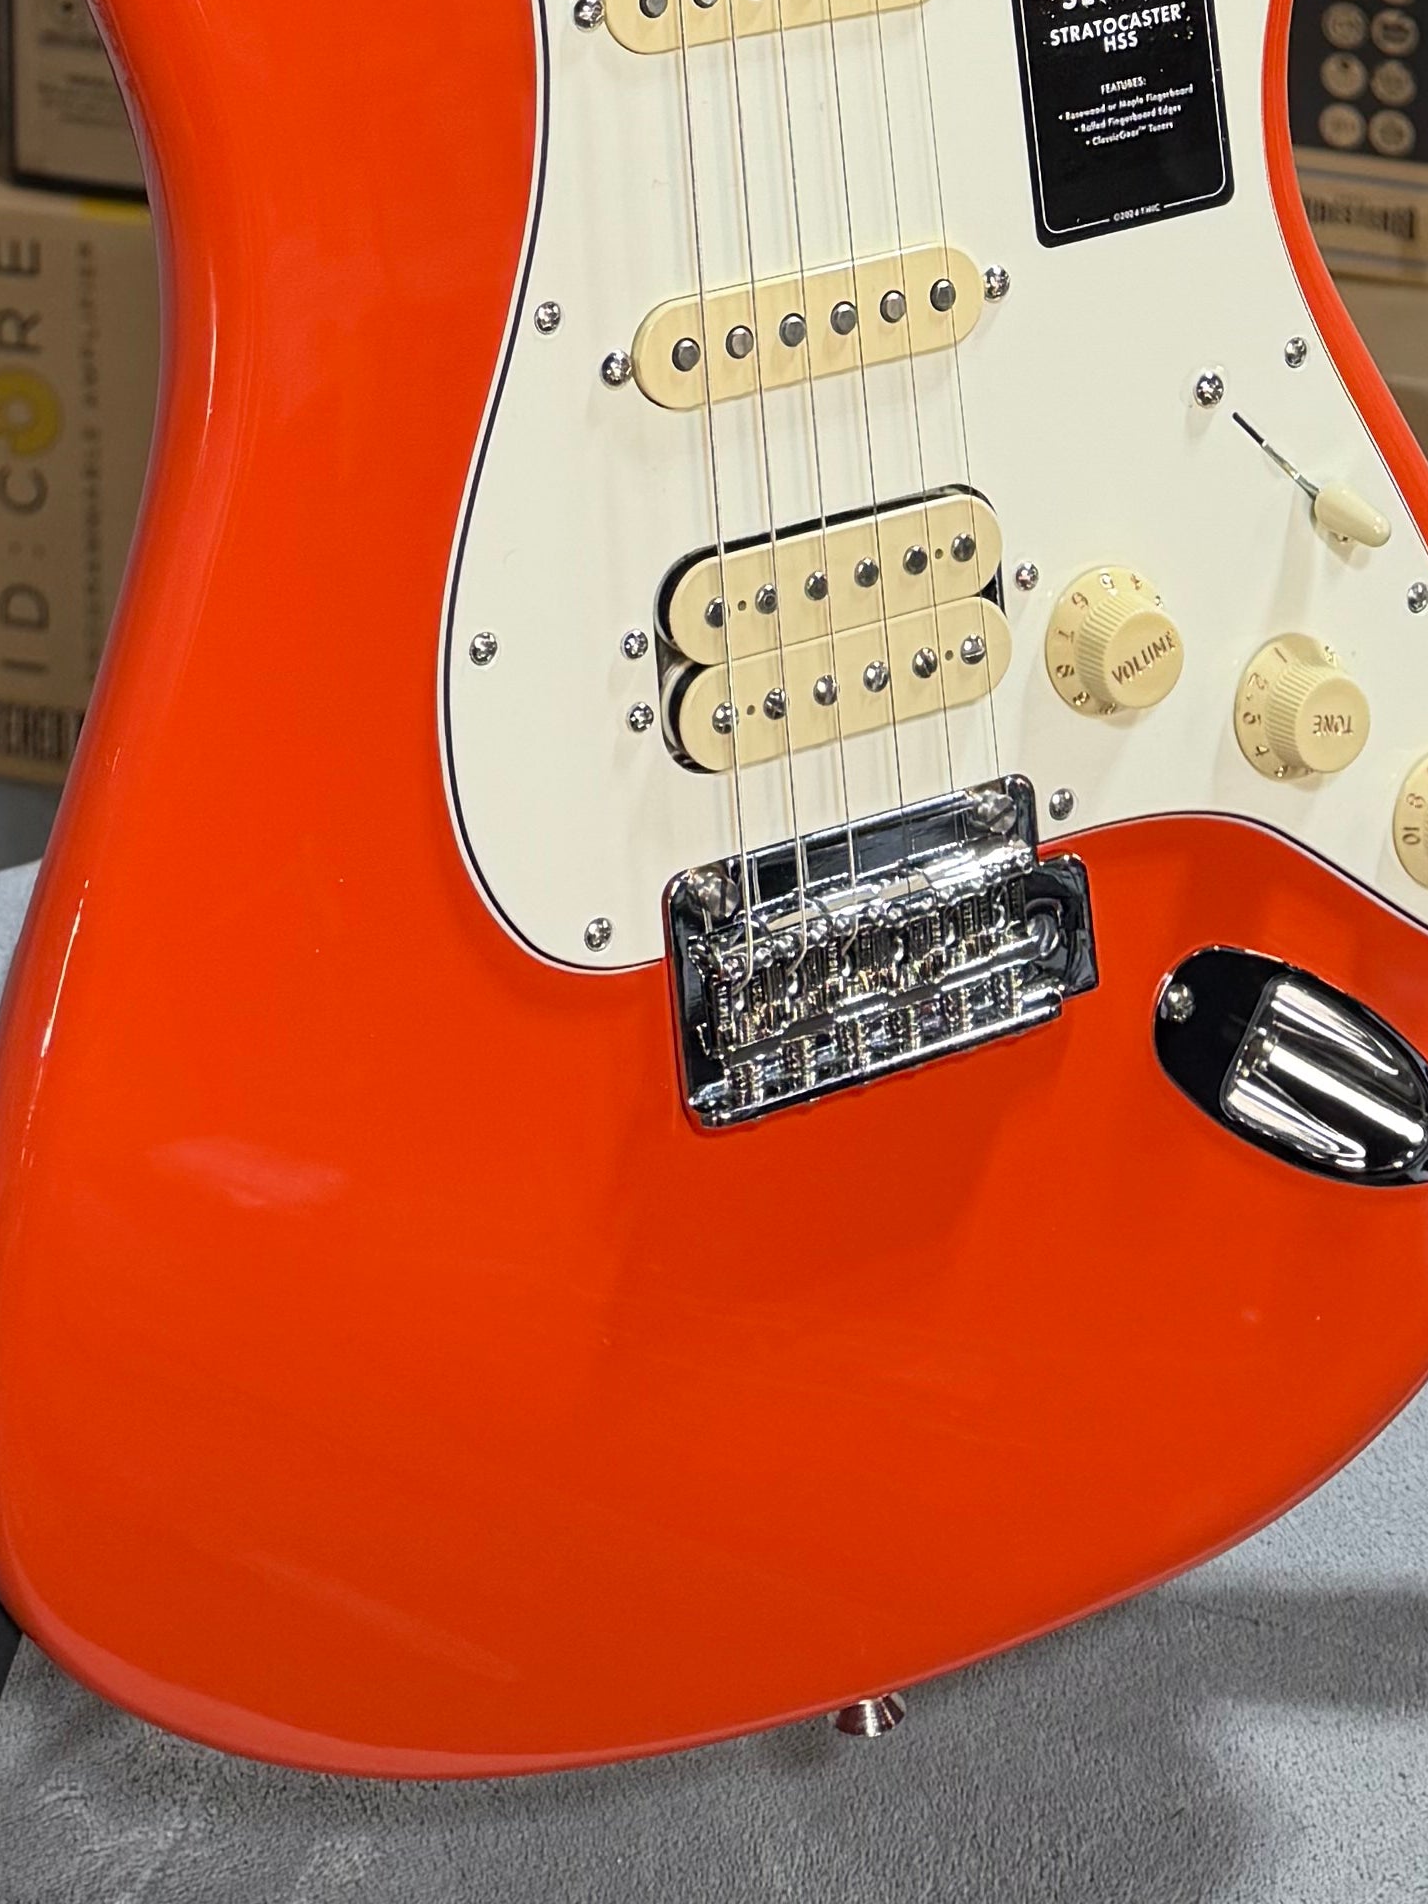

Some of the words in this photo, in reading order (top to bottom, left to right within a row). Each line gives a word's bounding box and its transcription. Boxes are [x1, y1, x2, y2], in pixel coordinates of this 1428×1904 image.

[1049, 2, 1185, 48] STRATOCASTER
[1103, 30, 1139, 54] HSS
[1112, 627, 1177, 685] VOLUME
[1312, 713, 1355, 735] TONE
